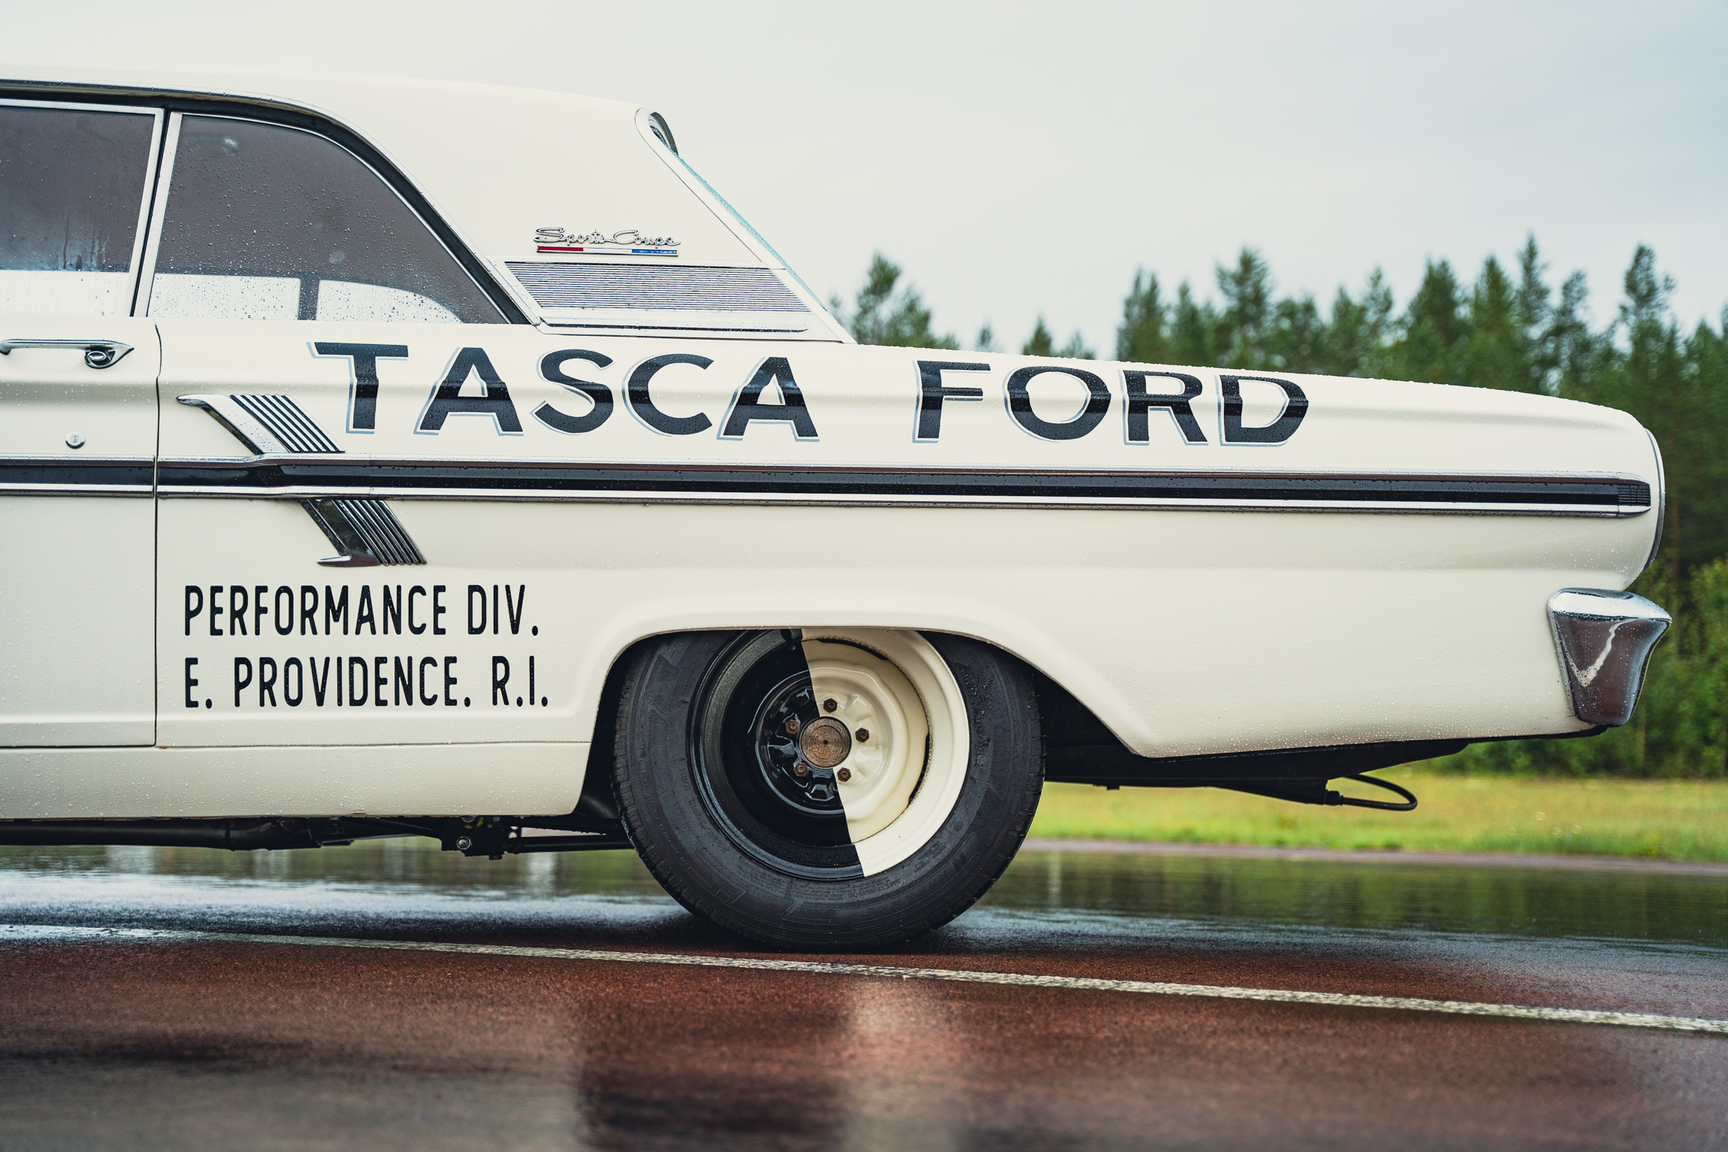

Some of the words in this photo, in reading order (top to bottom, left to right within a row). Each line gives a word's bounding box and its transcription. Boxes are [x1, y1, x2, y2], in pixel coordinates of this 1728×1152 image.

[533, 227, 606, 246] Sports
[612, 229, 682, 249] Coupe
[306, 341, 821, 442] TASCA
[912, 360, 1309, 447] FORD
[184, 584, 446, 636] PERFORMANCE
[467, 584, 539, 636] DIV.
[184, 657, 213, 709] E.
[234, 656, 471, 707] PROVIDENCE.
[492, 655, 548, 707] R.I.
